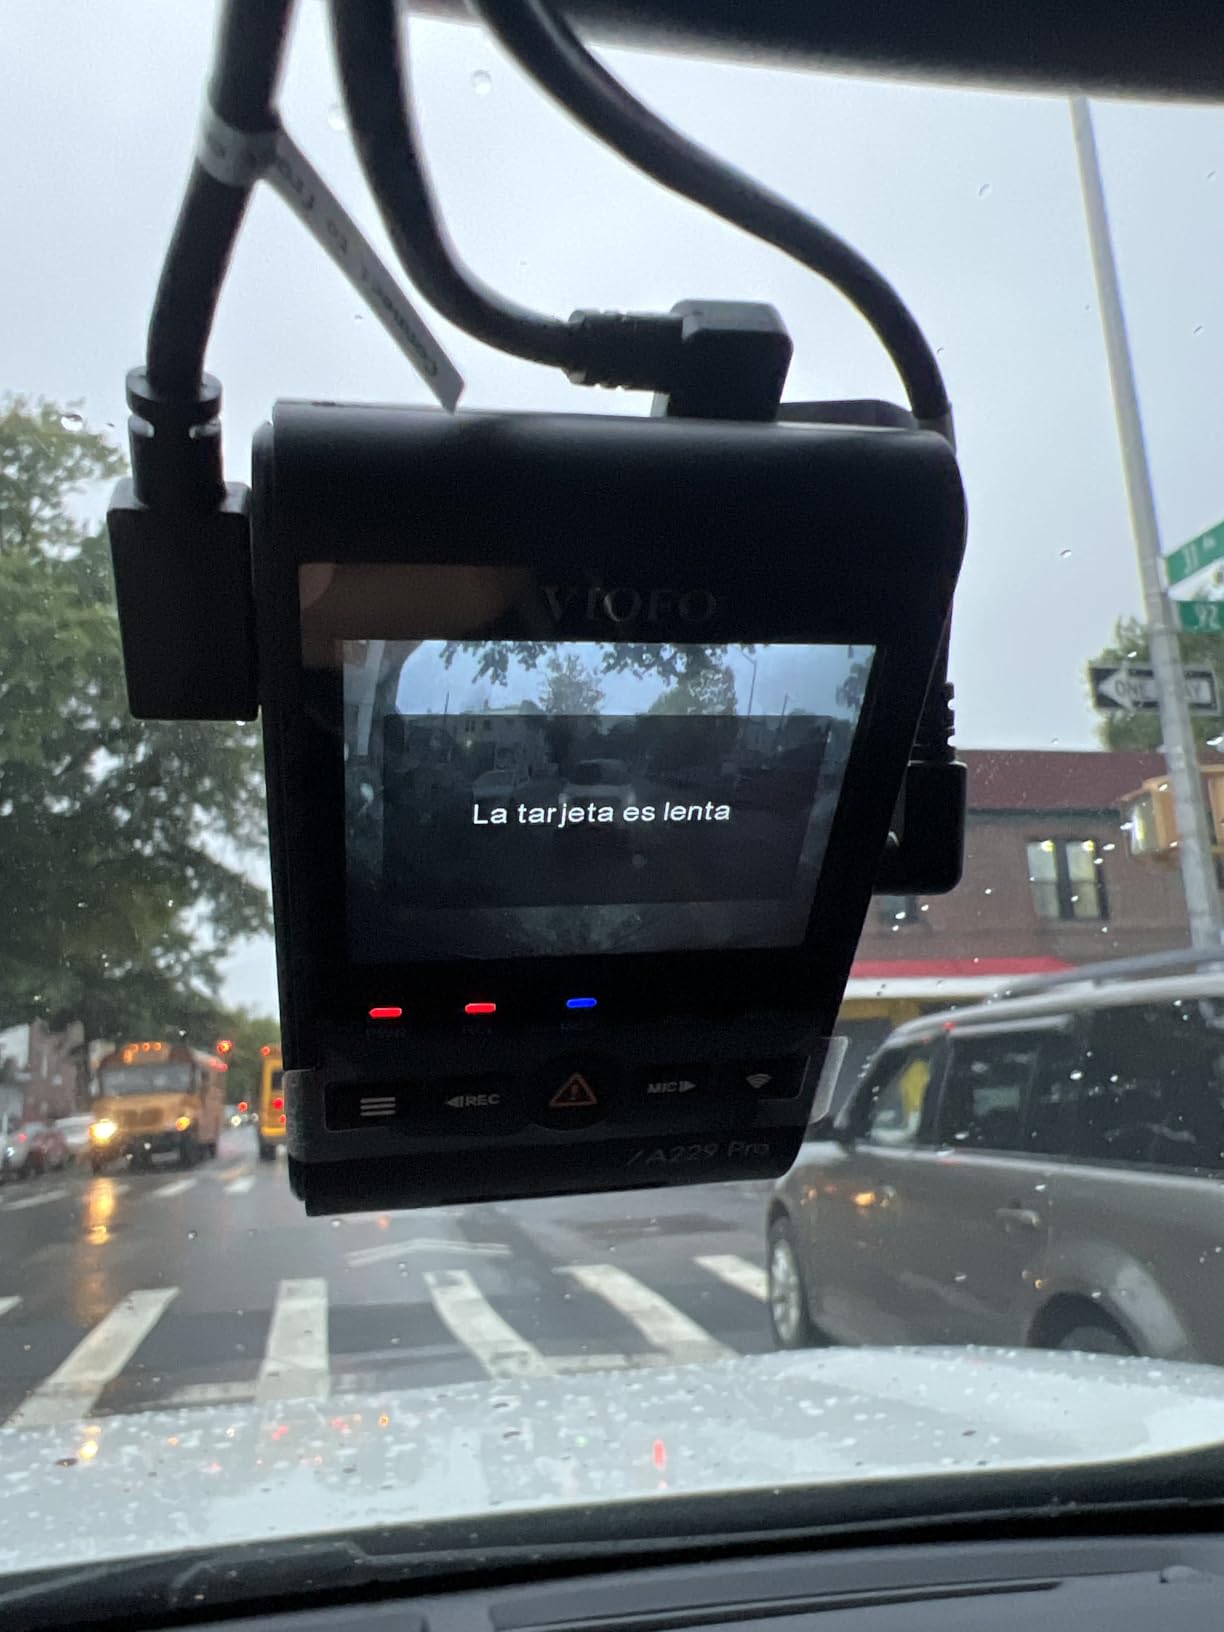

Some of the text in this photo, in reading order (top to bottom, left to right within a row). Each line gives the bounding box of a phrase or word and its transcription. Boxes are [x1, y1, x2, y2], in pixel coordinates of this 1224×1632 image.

[539, 586, 718, 623] VIOFO
[472, 801, 732, 829] La tarjeta es lenta
[647, 1081, 678, 1094] MIC
[465, 1092, 501, 1107] REC
[727, 1140, 770, 1157] Pro
